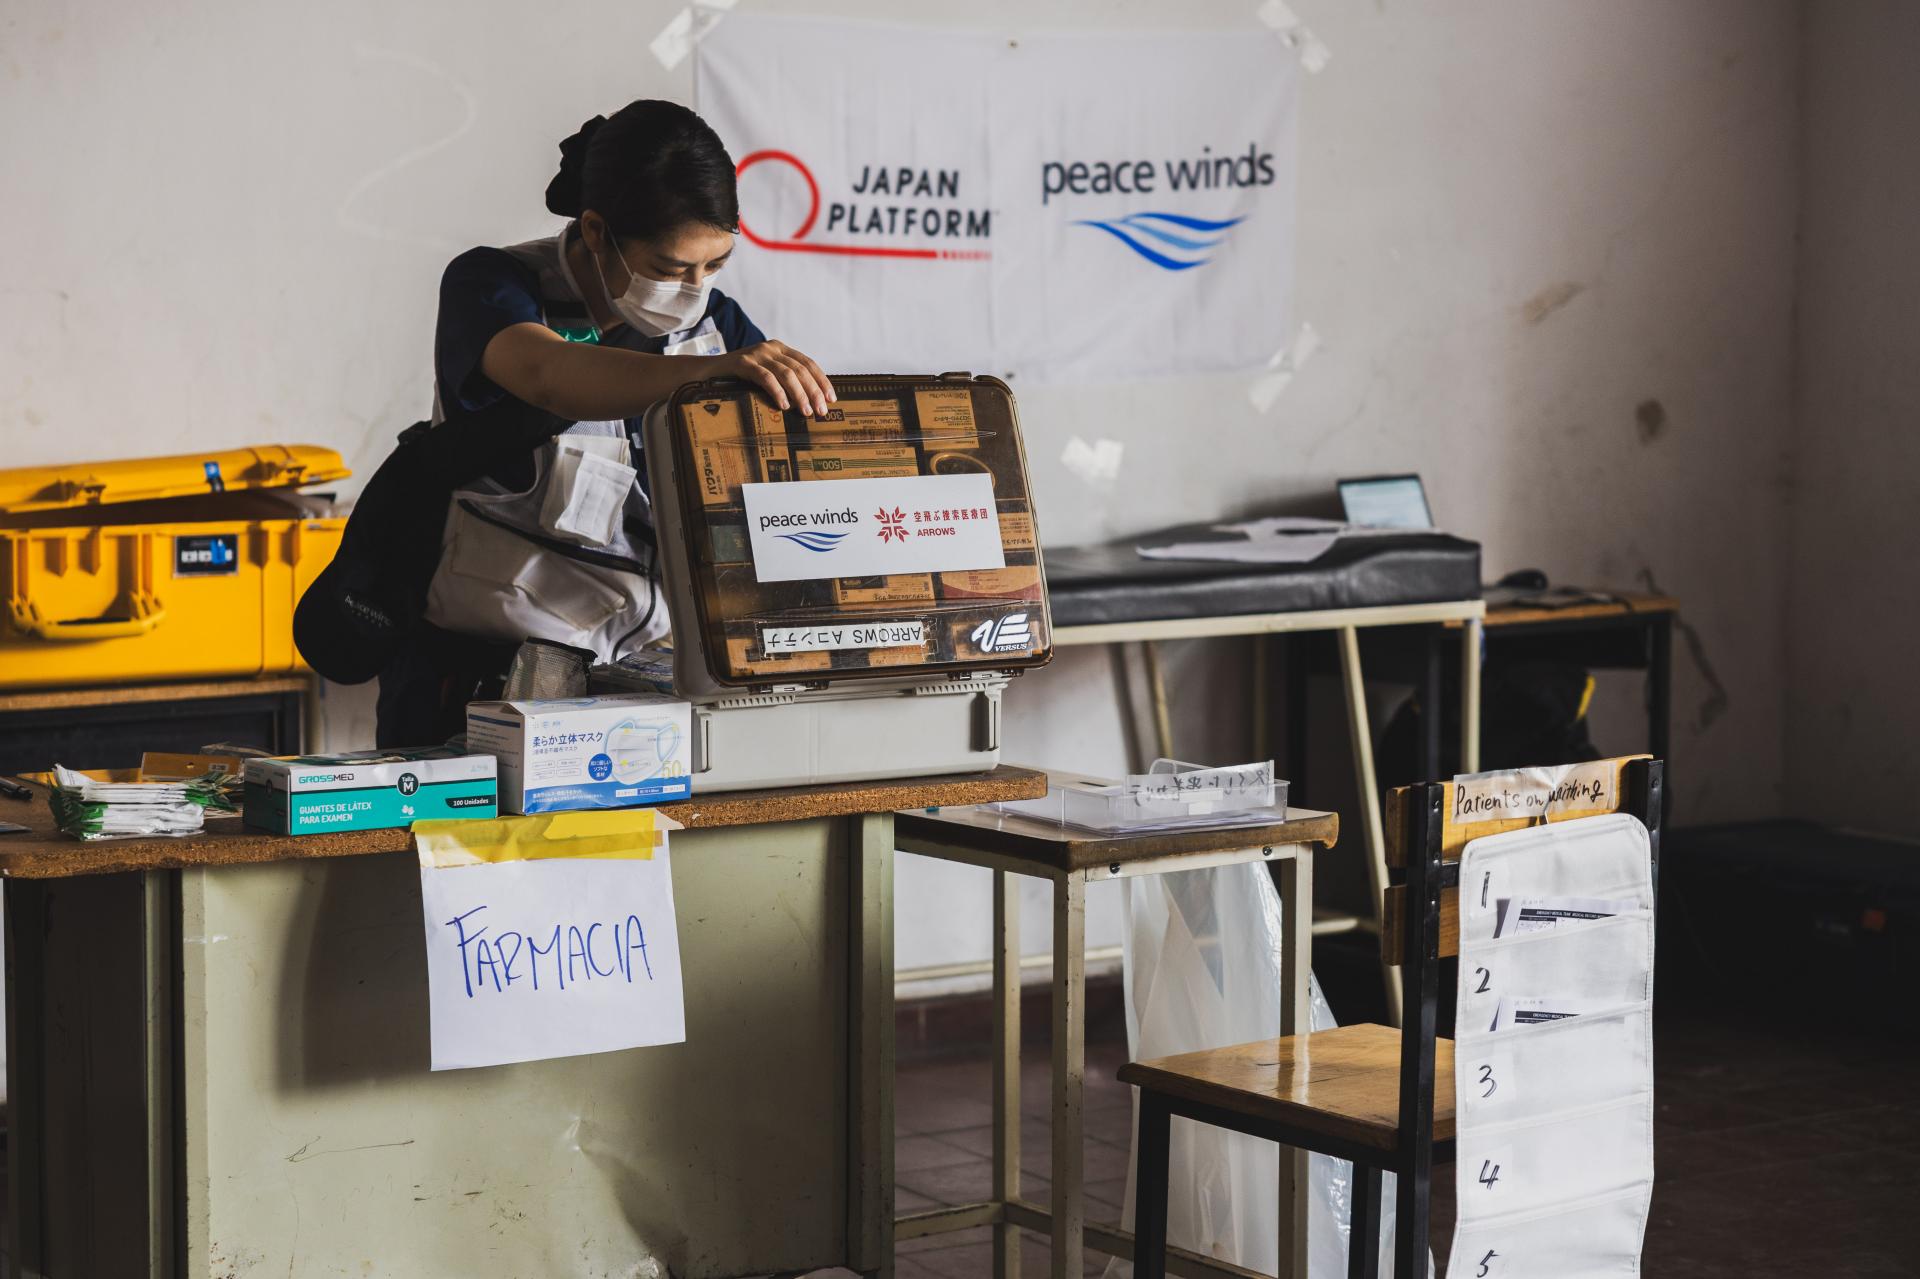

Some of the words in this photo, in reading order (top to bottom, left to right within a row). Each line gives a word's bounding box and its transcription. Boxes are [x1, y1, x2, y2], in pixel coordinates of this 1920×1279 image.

[852, 165, 959, 197] JAPAN
[1042, 158, 1154, 204] peace
[1166, 143, 1275, 191] winds
[827, 203, 991, 238] PLATFORM
[759, 513, 807, 532] peace
[812, 508, 858, 525] winds
[917, 527, 956, 537] ARROWS
[854, 626, 921, 644] ARROWS
[995, 642, 1028, 653] VERSUS
[532, 731, 604, 748] 柔らか立体マスク
[298, 773, 355, 784] GROSSMED
[403, 782, 414, 792] M
[299, 804, 335, 815] GUANTES
[336, 803, 346, 812] DE
[347, 800, 372, 811] LÁTEX
[453, 799, 463, 807] 100
[464, 797, 489, 806] Unidades
[1456, 783, 1520, 816] Patients
[1526, 794, 1544, 808] on
[299, 815, 320, 825] PARA
[321, 813, 353, 823] EXAMEN
[1480, 871, 1492, 908] 1
[445, 905, 653, 998] FARMACIA
[1475, 966, 1492, 994] 2
[1479, 1064, 1498, 1098] 3
[1479, 1158, 1501, 1191] 4
[1476, 1248, 1501, 1278] 5
